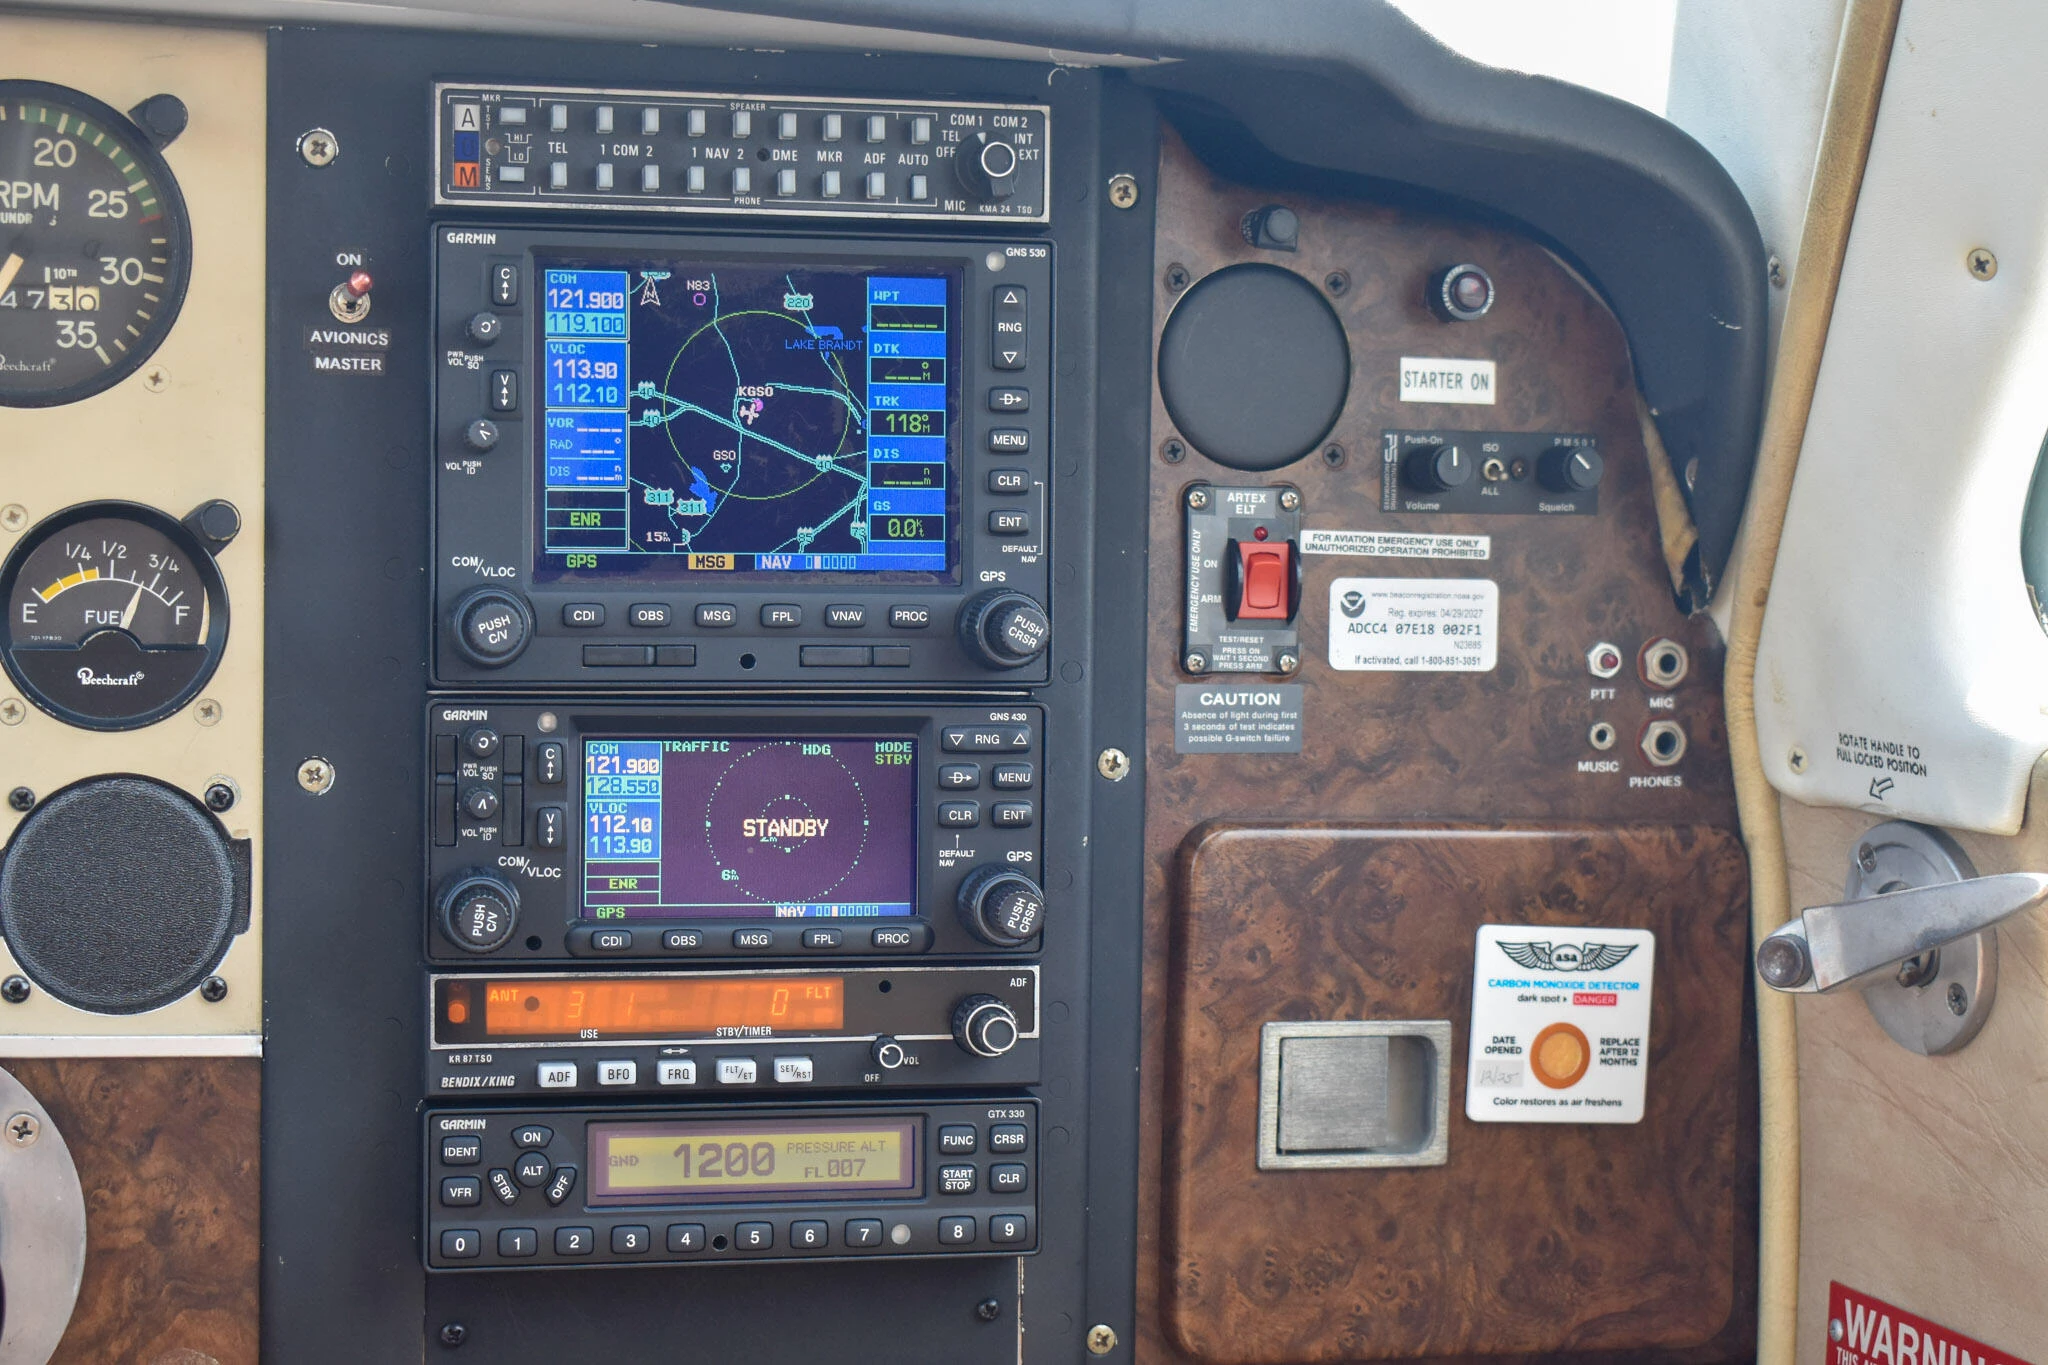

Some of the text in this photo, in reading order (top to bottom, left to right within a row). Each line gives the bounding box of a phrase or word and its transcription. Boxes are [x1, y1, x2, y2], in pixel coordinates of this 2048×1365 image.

[730, 102, 766, 111] SPEAKER
[942, 131, 960, 142] TEL
[34, 138, 76, 168] 20
[548, 142, 568, 154] TEL
[773, 150, 798, 161] DME
[899, 154, 928, 166] AUTO
[0, 181, 59, 210] RPM
[734, 196, 761, 205] PHONE
[89, 190, 128, 218] 25
[945, 201, 965, 212] MIC
[1018, 206, 1032, 214] TSO
[447, 233, 496, 244] GARMIN
[1006, 248, 1045, 257] GNS 530
[337, 253, 361, 265] ON
[100, 257, 143, 286] 30
[548, 289, 624, 309] 121.900
[550, 314, 623, 332] 119.100
[56, 320, 97, 349] 35
[311, 331, 388, 345] AVIONICS
[551, 344, 585, 354] VLOC
[785, 340, 863, 351] LAKE BRANDT
[316, 357, 381, 370] MASTER
[554, 360, 617, 379] 113.90
[1405, 371, 1489, 390] STARTER ON
[554, 384, 617, 403] 112.10
[994, 435, 1026, 445] MENU
[1405, 436, 1443, 444] Push-On
[998, 476, 1020, 485] CLR
[1228, 493, 1266, 503] ARTEX
[1236, 505, 1256, 514] ELT
[1539, 503, 1574, 512] Squelch
[570, 512, 601, 526] ENR
[999, 517, 1021, 526] ENT
[1334, 535, 1375, 544] AVIATION
[1378, 537, 1433, 545] EMERGENCY
[1456, 540, 1479, 548] ONLY
[67, 543, 91, 559] 1/4
[103, 541, 127, 557] 1/2
[1305, 544, 1485, 557] UNAUTHORIZED OPERATION PROHIBITED
[149, 555, 179, 572] 3/4
[1204, 560, 1217, 568] ON
[980, 571, 1006, 582] GPS
[1189, 528, 1202, 633] EMERGENCY USE ONLY
[1201, 595, 1222, 603] ARM
[574, 611, 594, 621] CDI
[1348, 623, 1481, 635] ADCC4 07E18 002F1
[1355, 656, 1360, 664] If
[1363, 656, 1401, 666] activated,
[1405, 656, 1419, 664] call
[1200, 693, 1281, 705] CAUTION
[1591, 689, 1616, 699] PTT
[1650, 698, 1674, 709] MIC
[443, 710, 487, 720] GARMIN
[1231, 712, 1249, 720] light
[1252, 712, 1278, 720] during
[1189, 735, 1222, 743] possible
[664, 741, 729, 752] TRAFFIC
[803, 745, 831, 755] HDG
[1839, 732, 1920, 759] ROTATE HANDLE TO
[588, 756, 659, 773] 121.900
[875, 755, 912, 764] STBY
[1854, 752, 1883, 768] LOCKED
[1886, 758, 1927, 777] POSITION
[1578, 761, 1619, 772] MUSIC
[1630, 776, 1681, 787] PHONES
[590, 803, 627, 813] VLOC
[590, 816, 652, 833] 112.10
[743, 819, 828, 837] STANDBY
[590, 836, 651, 853] 113.90
[609, 879, 638, 889] ENR
[1488, 979, 1639, 990] CARBON MONOXIDE DETECTOR
[489, 989, 518, 1002] ANT
[1541, 995, 1560, 1004] spot
[1574, 995, 1615, 1004] DANGER
[716, 1026, 772, 1037] STBY/TIMER
[1493, 1036, 1516, 1045] DATE
[1600, 1058, 1637, 1066] MONTHS
[441, 1076, 515, 1088] BENDIX/KING
[1493, 1097, 1517, 1105] Color
[1521, 1098, 1556, 1106] restores
[1571, 1098, 1582, 1106] air
[1585, 1098, 1622, 1106] freshens
[988, 1110, 1024, 1118] GTX 330
[440, 1120, 486, 1130] GARMIN
[523, 1132, 540, 1142] ON
[944, 1136, 973, 1145] FUNC
[994, 1135, 1024, 1144] CRSR
[445, 1148, 477, 1157] IDENT
[788, 1140, 886, 1154] PRESSURE ALT
[609, 1156, 639, 1166] GND
[673, 1142, 775, 1178] 1200
[523, 1166, 542, 1176] ALT
[943, 1170, 972, 1178] START
[999, 1174, 1019, 1183] CLR
[450, 1188, 472, 1197] VFR
[493, 1174, 514, 1201] STBY
